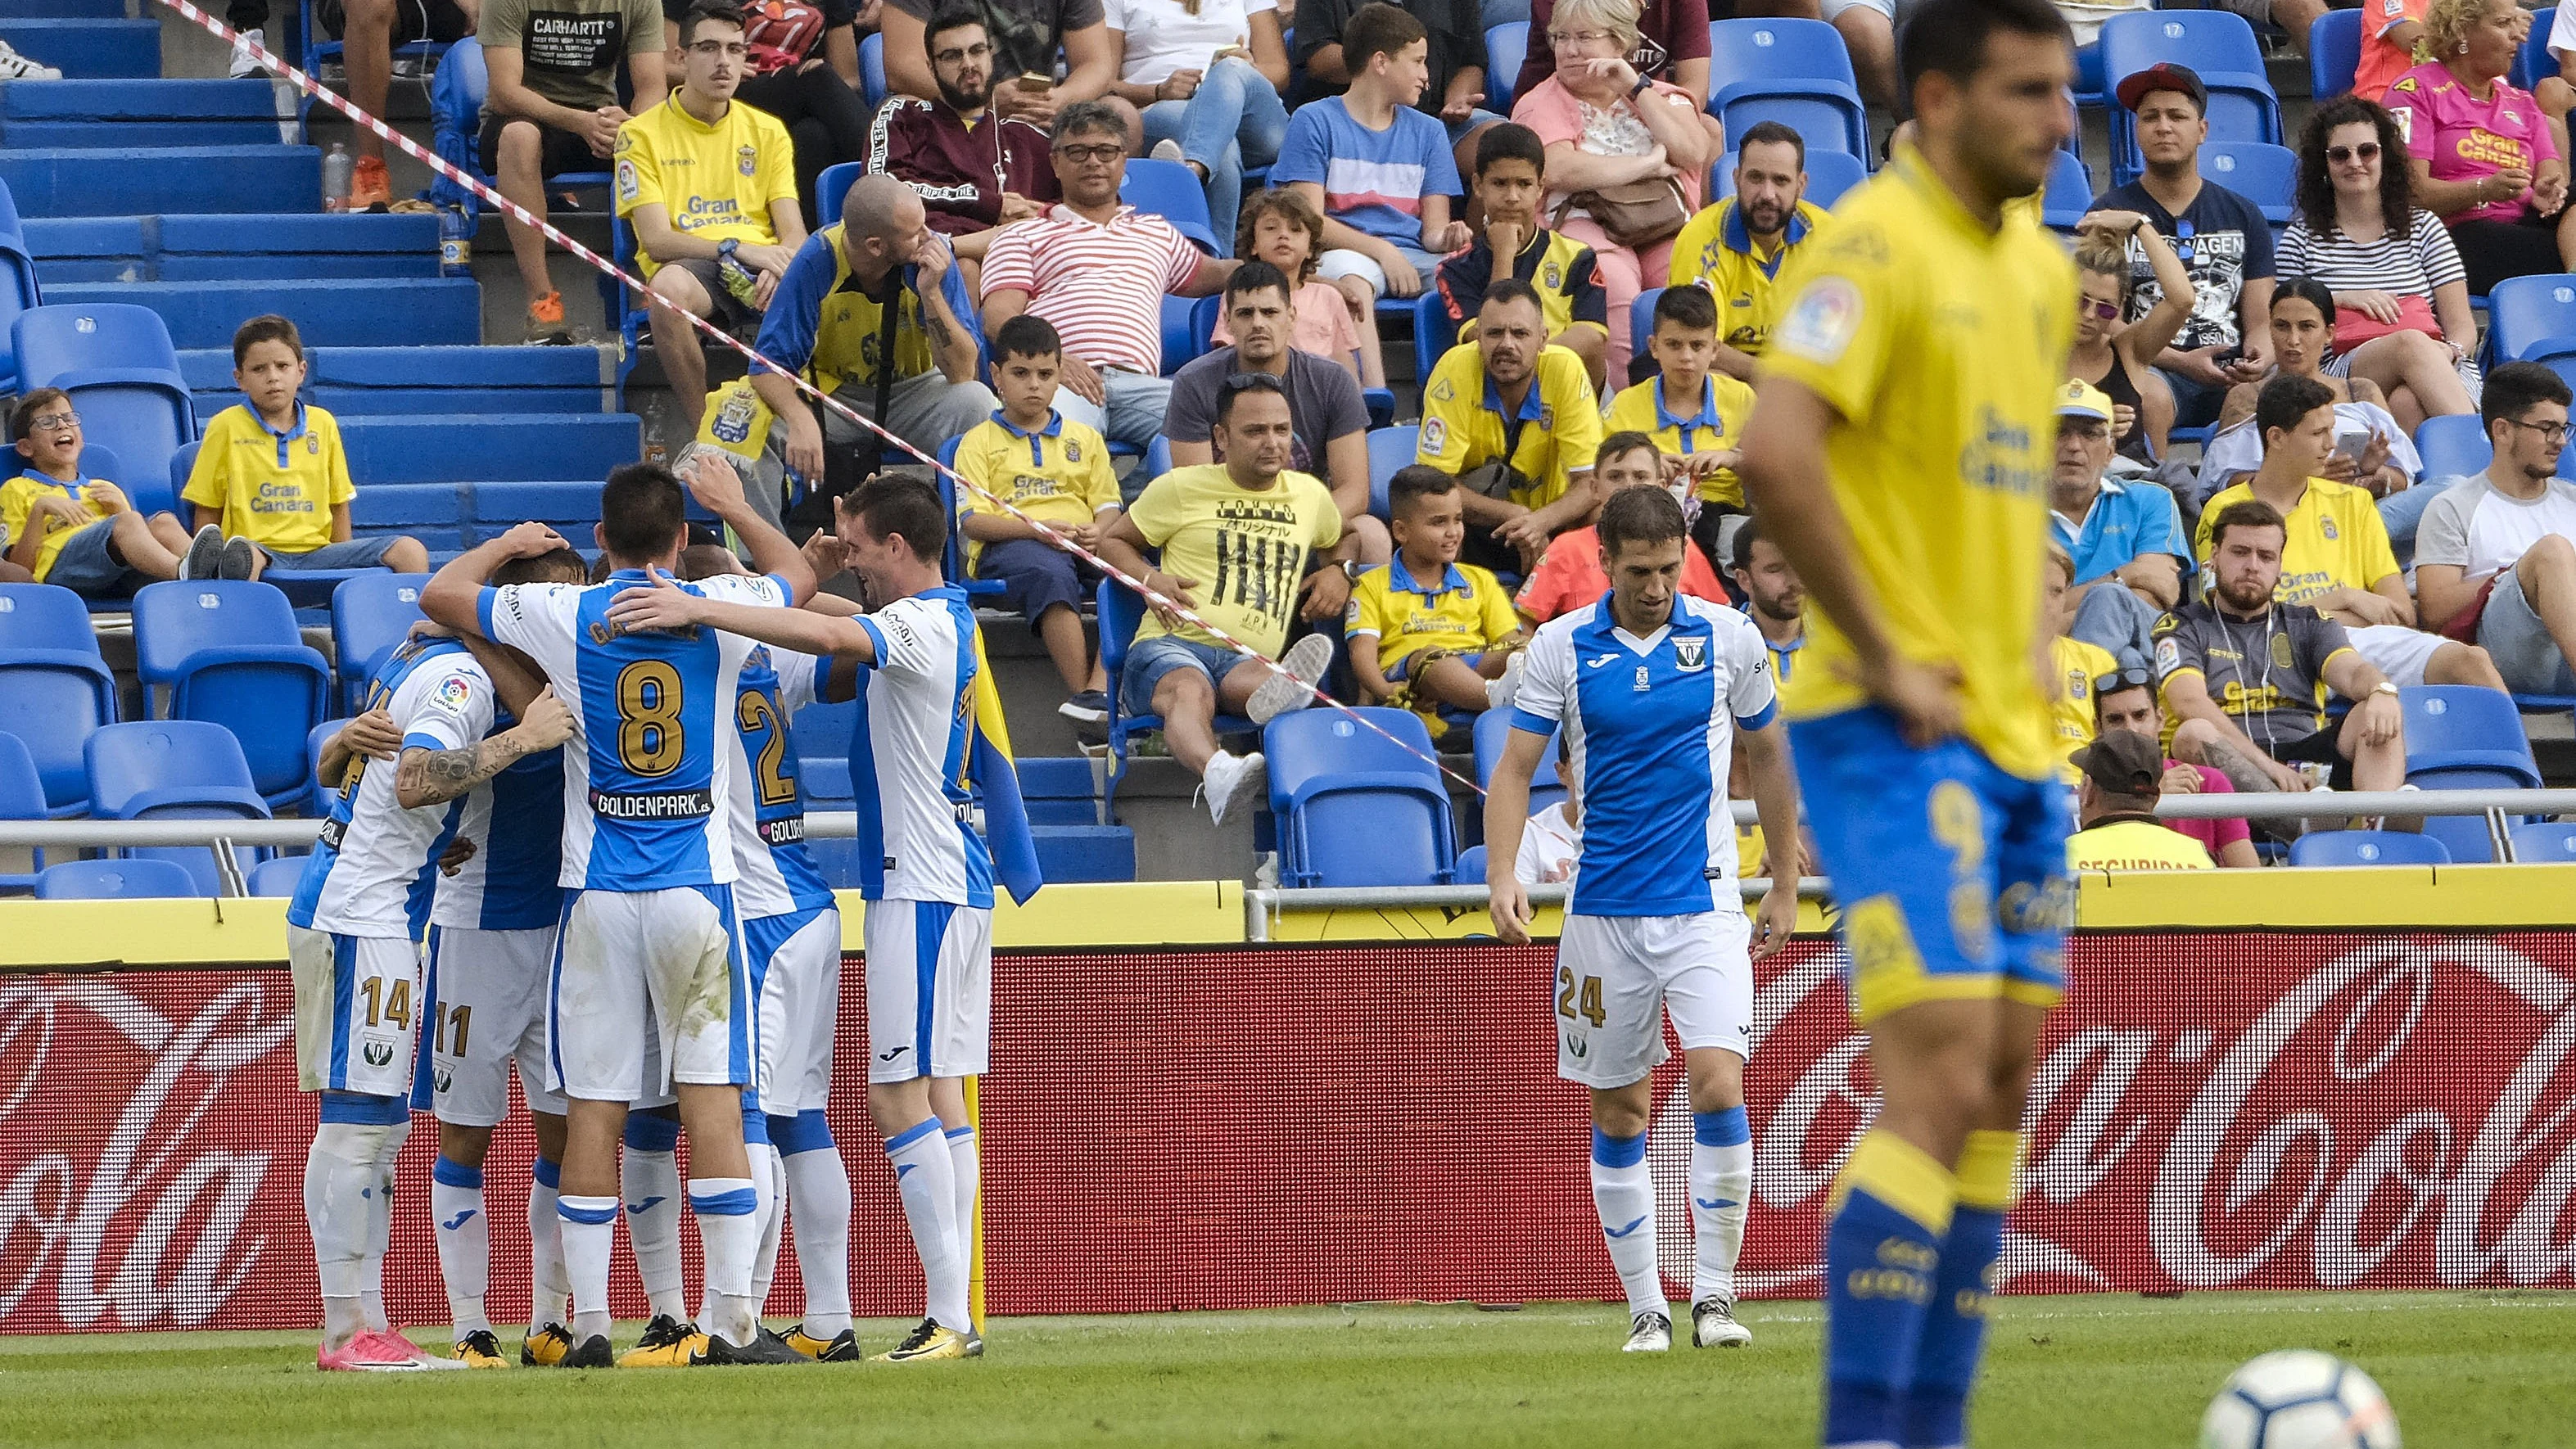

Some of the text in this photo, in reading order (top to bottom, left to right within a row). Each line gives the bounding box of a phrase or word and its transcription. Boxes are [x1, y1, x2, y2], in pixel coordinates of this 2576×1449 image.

[2456, 138, 2529, 169] Canari
[2470, 128, 2520, 154] Gran
[688, 196, 738, 214] Gran
[260, 482, 301, 498] Gran
[1217, 499, 1294, 522] TOKYO
[433, 696, 459, 712] LaLiga
[616, 658, 684, 777] 8
[360, 975, 411, 1031] 14
[1558, 965, 1606, 1028] 24
[436, 1000, 472, 1058] 11
